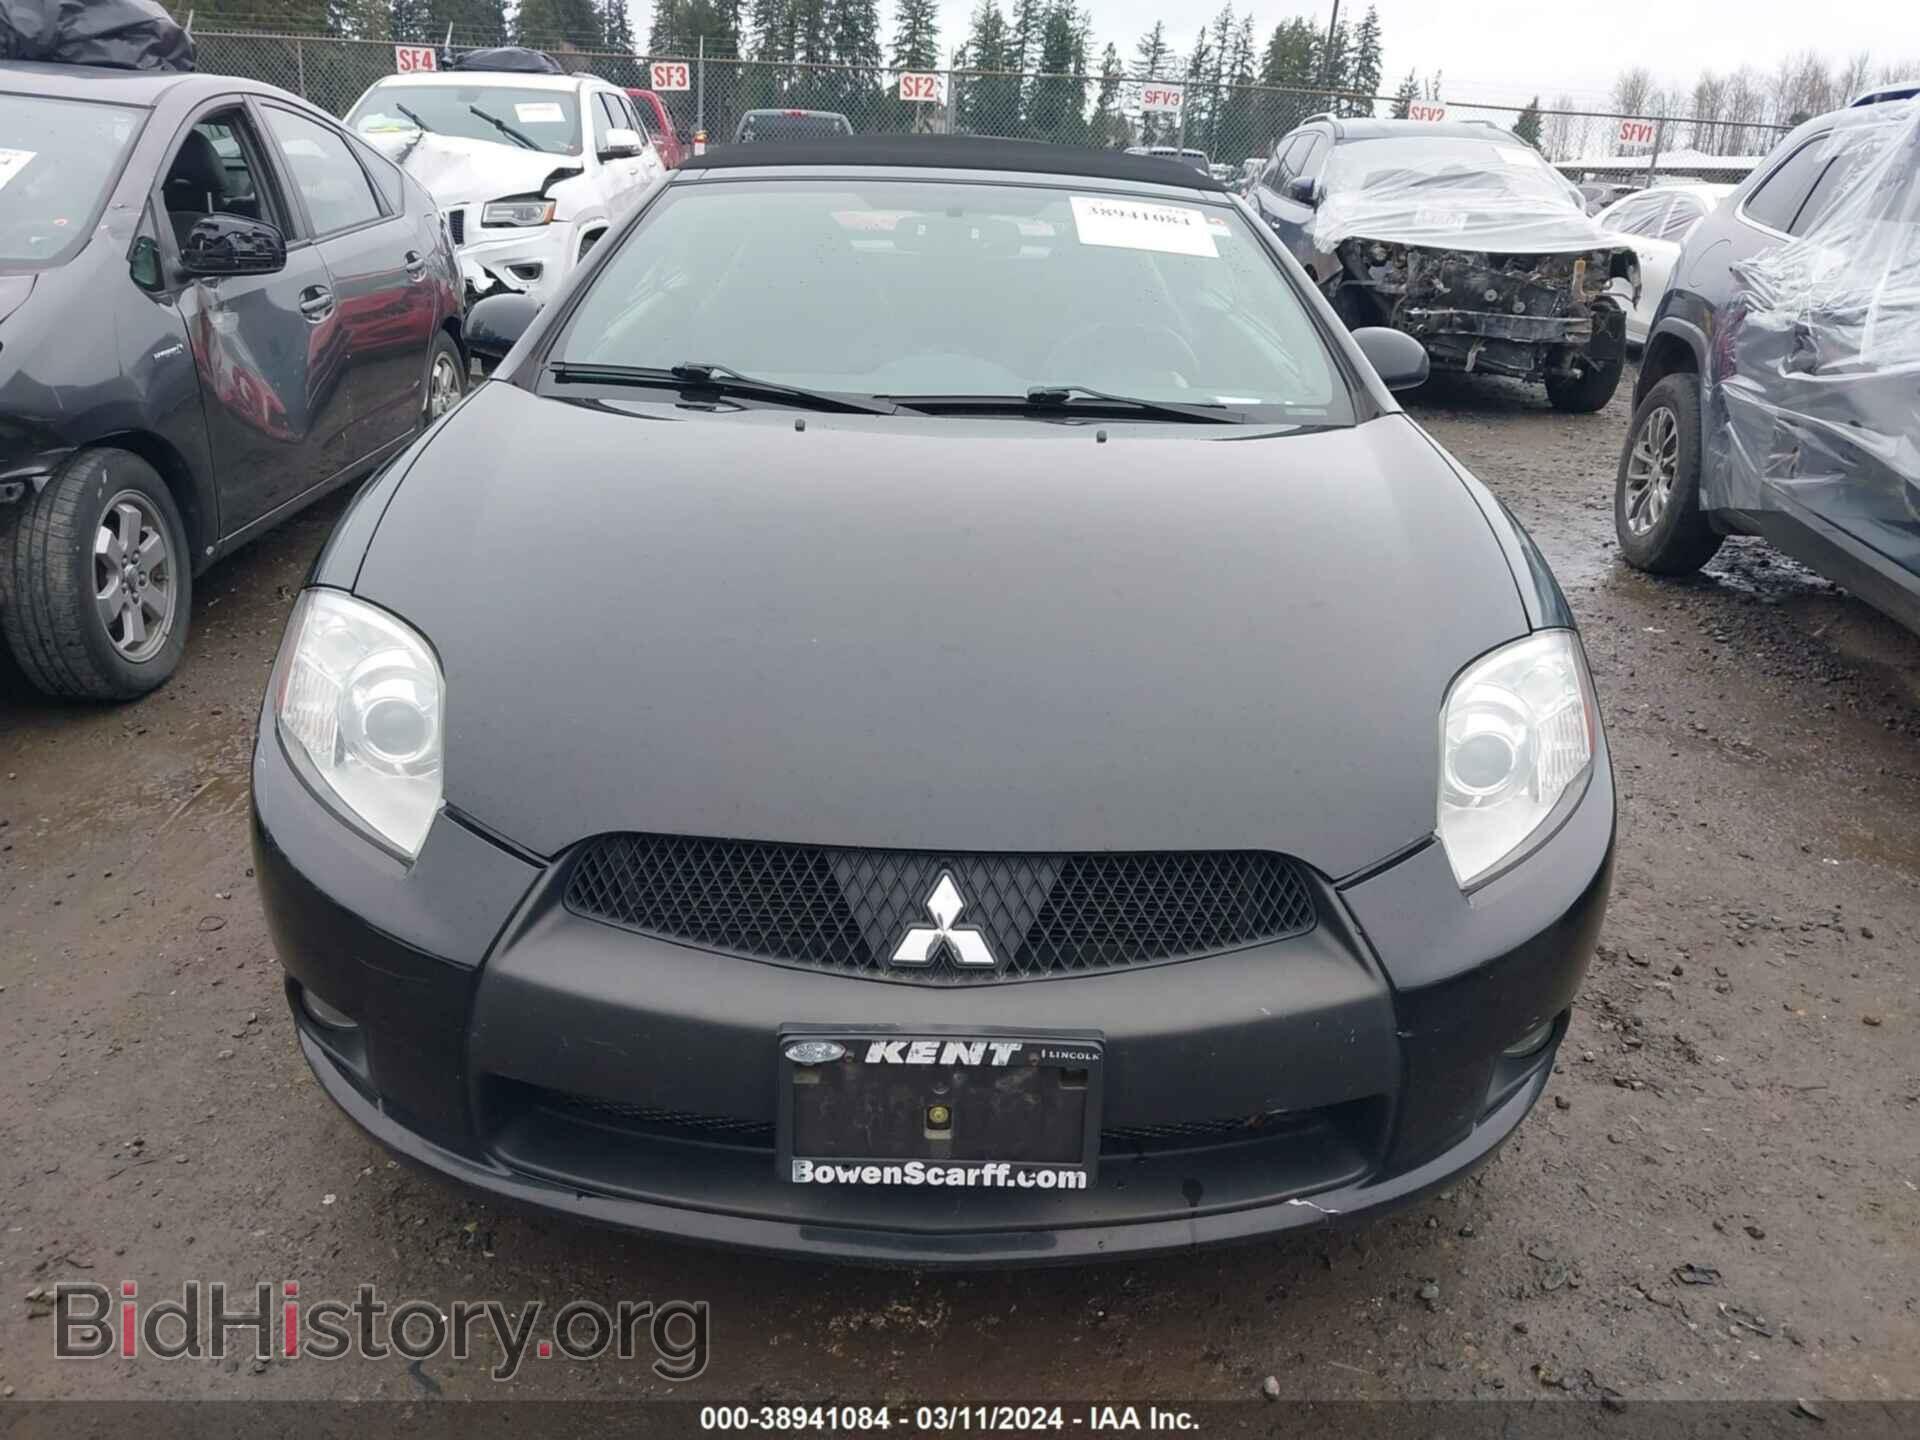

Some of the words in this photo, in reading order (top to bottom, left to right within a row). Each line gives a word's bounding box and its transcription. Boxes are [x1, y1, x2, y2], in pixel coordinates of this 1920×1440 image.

[399, 49, 433, 71] SF4
[654, 66, 687, 87] SF3
[903, 76, 934, 97] SF2
[1144, 90, 1180, 106] SFV3
[1620, 123, 1652, 142] SFV1
[864, 1040, 1023, 1066] KENT
[792, 1159, 1087, 1189] BowenScarff.com
